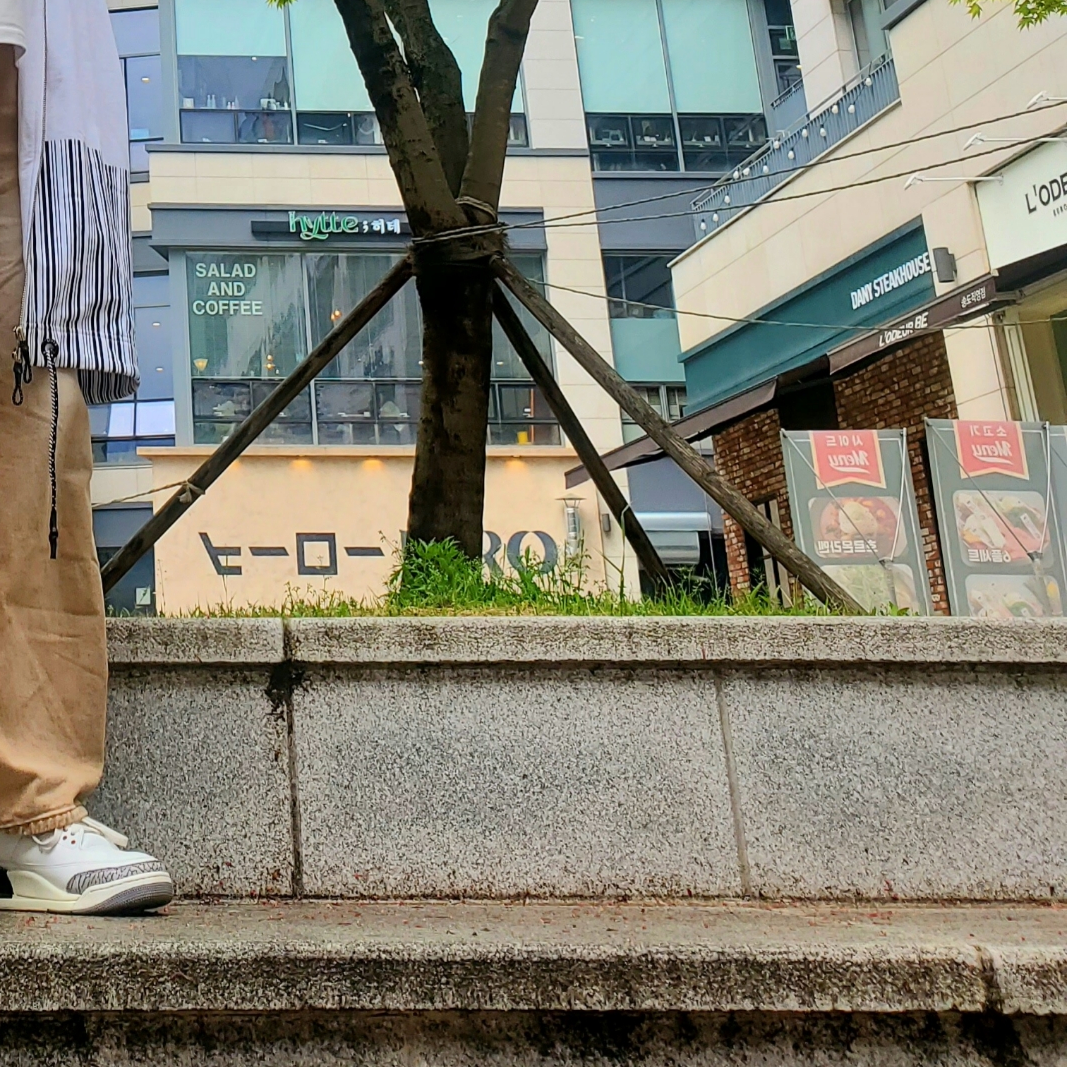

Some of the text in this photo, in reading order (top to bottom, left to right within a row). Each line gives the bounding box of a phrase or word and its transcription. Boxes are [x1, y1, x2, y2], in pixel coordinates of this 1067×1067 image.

[288, 210, 359, 241] hytte
[195, 263, 257, 278] SALAD
[873, 251, 931, 298] STEAKHOUSE
[207, 281, 246, 297] AND
[192, 300, 263, 316] COFFEE
